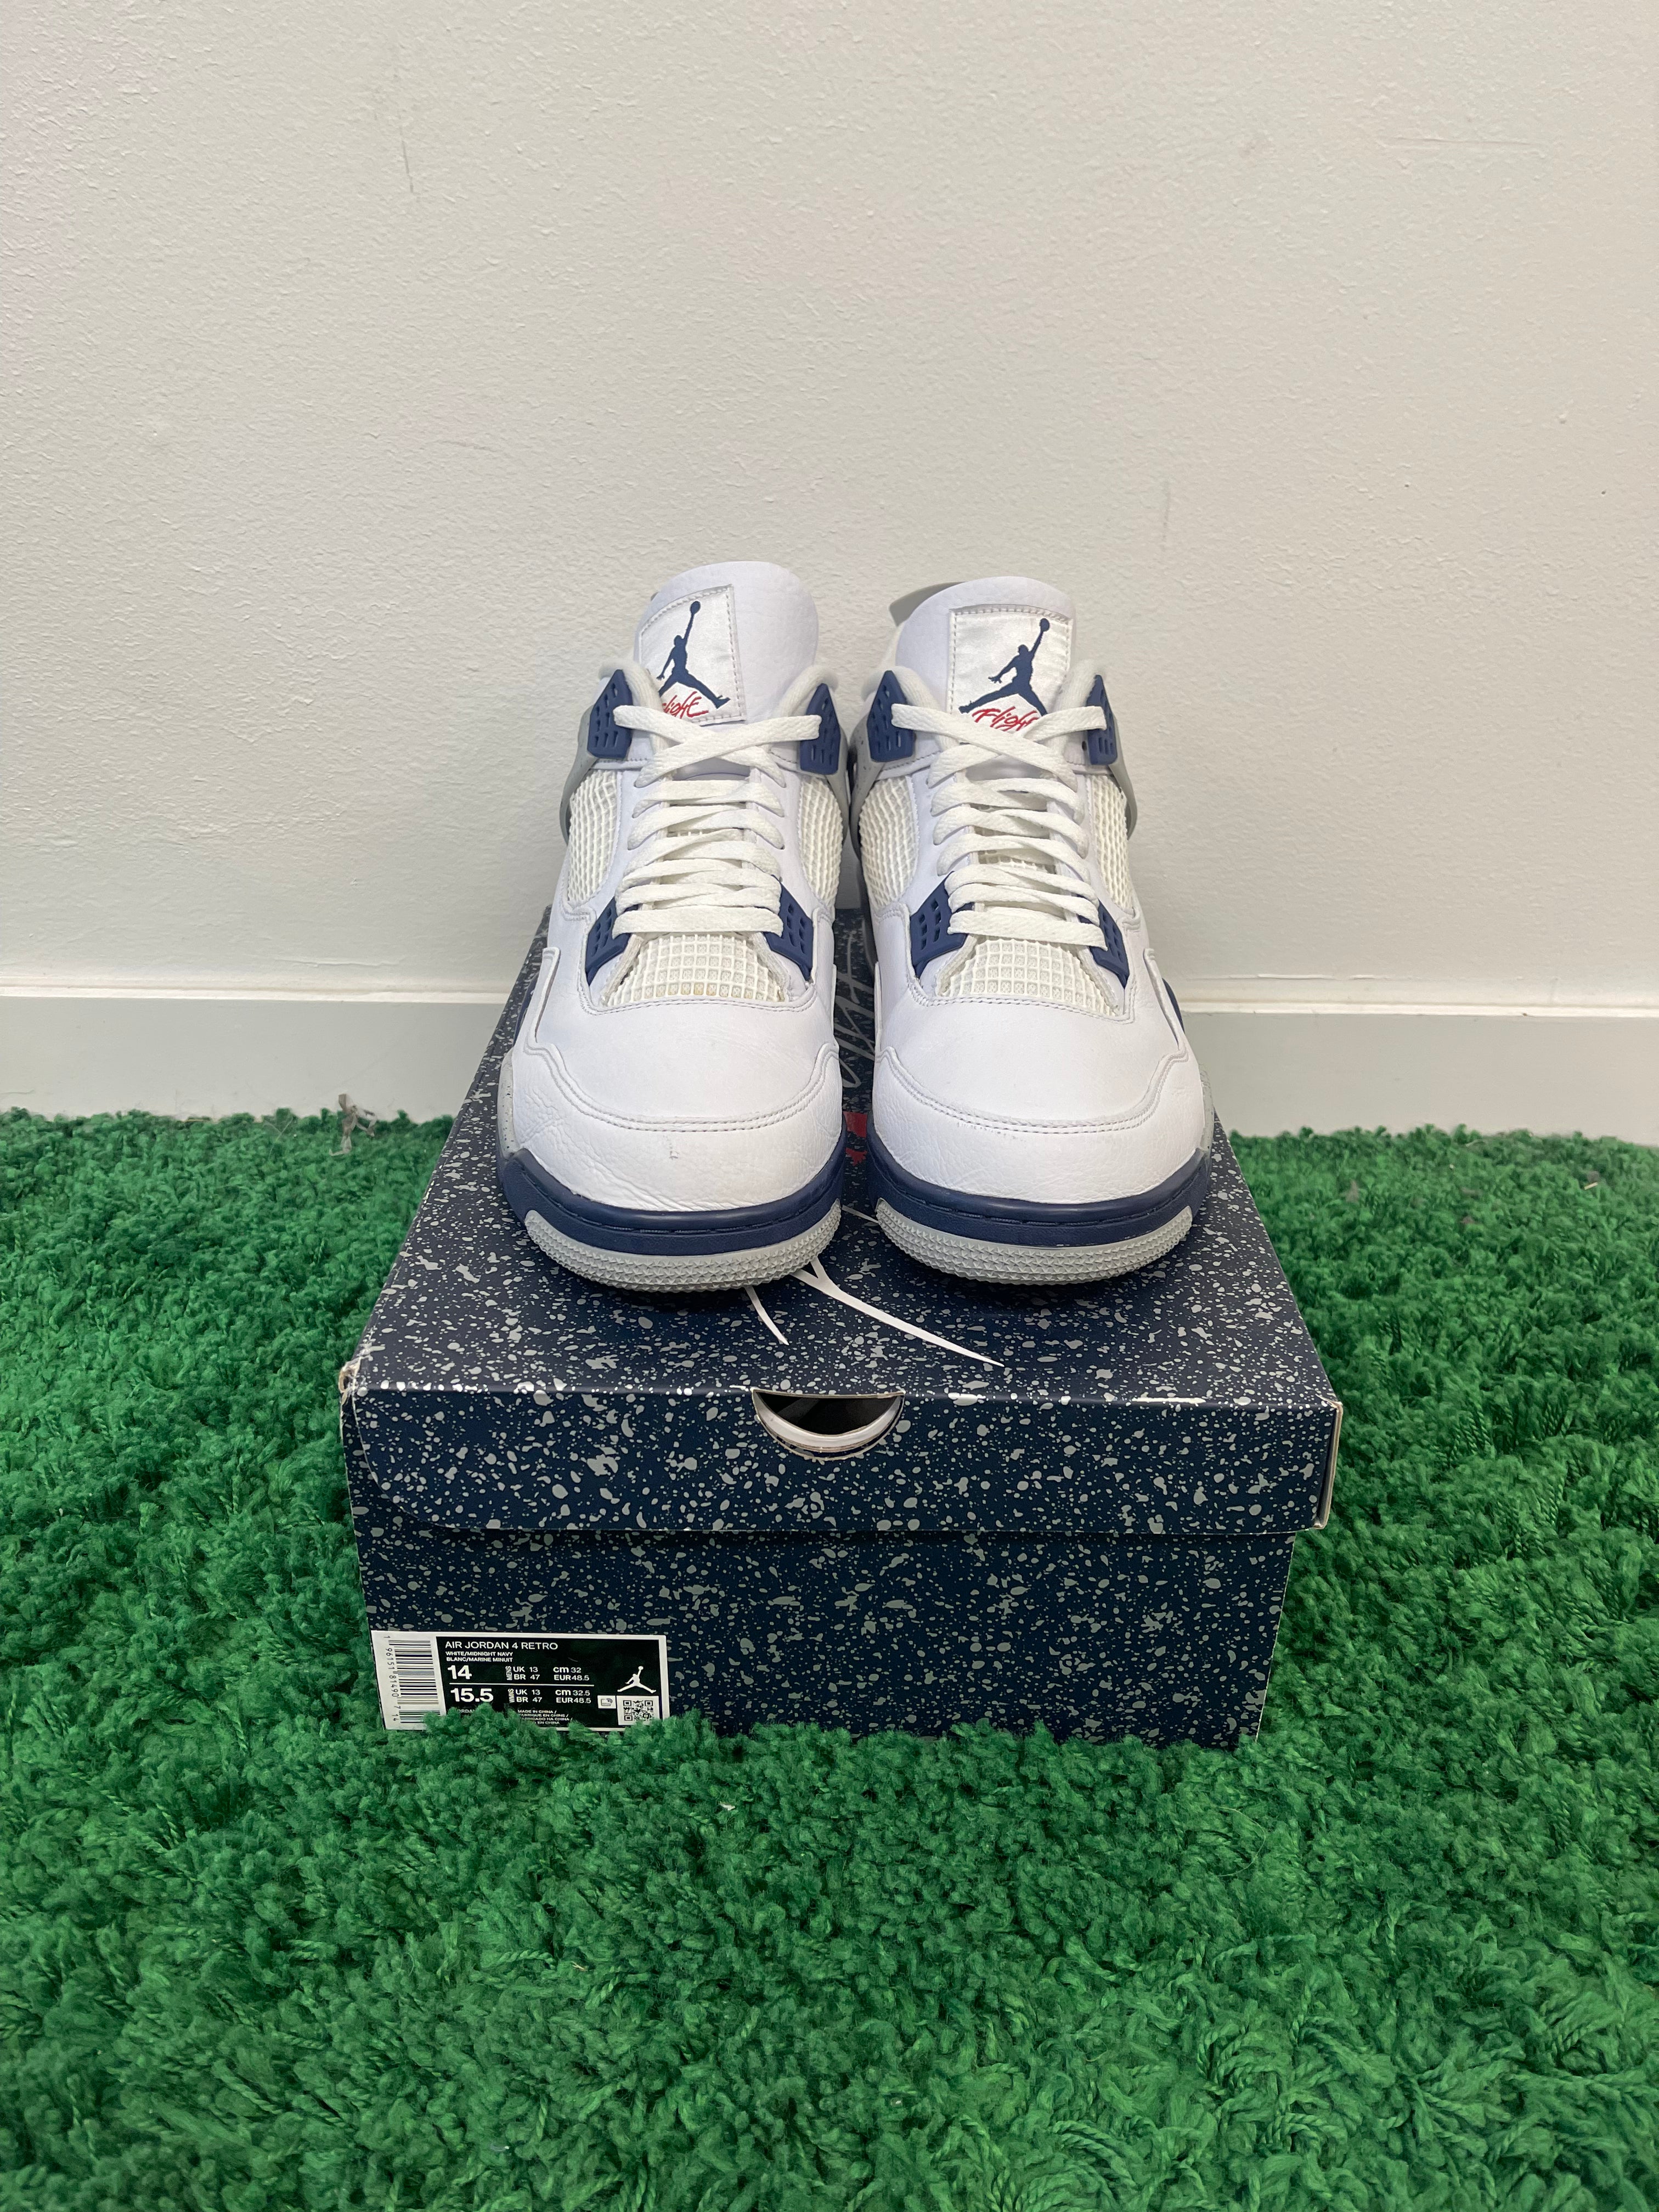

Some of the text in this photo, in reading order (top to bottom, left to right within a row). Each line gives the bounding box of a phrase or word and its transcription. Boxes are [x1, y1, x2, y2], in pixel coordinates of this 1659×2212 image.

[385, 1647, 395, 1669] 96151
[447, 1664, 472, 1680] 14
[389, 1675, 399, 1697] 81490
[450, 1688, 494, 1702] 15.5
